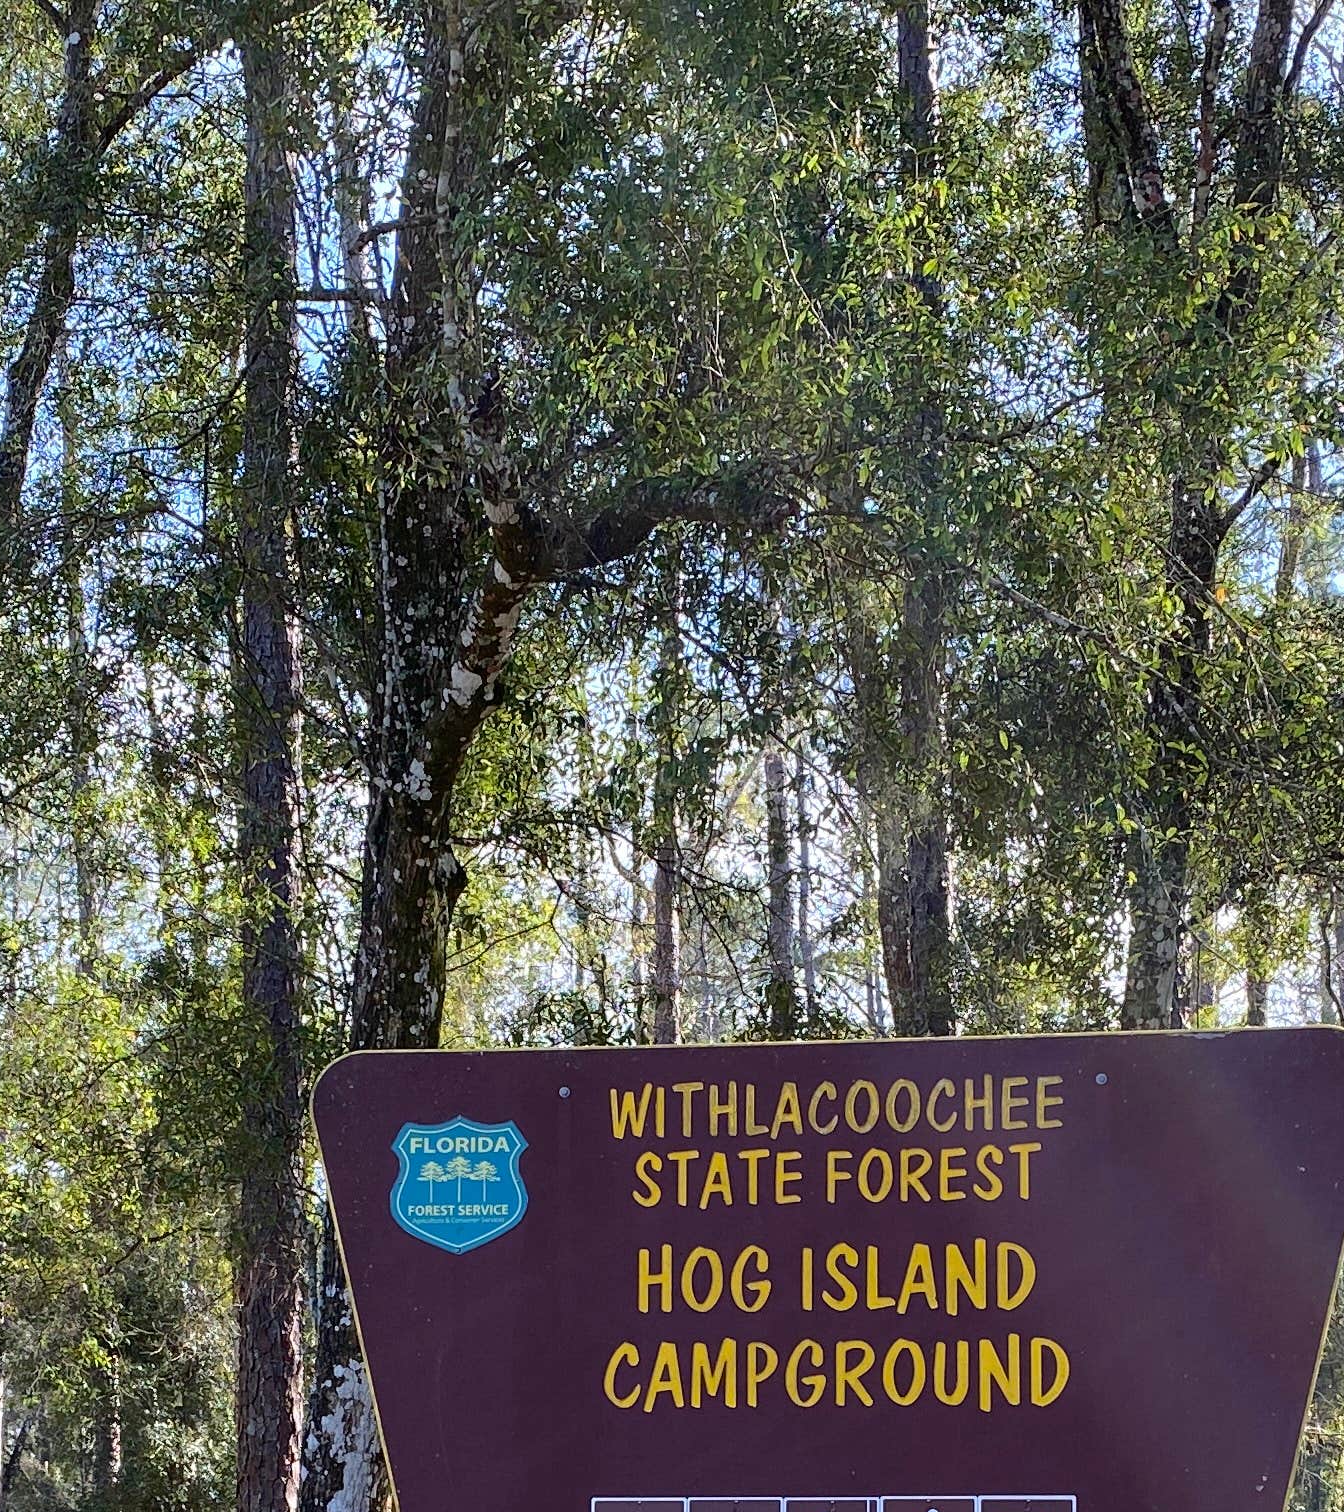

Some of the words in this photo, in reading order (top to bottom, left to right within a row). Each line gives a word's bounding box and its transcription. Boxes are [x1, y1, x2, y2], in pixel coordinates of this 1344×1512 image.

[609, 1074, 1064, 1140] WITHLACOOCHEE
[409, 1136, 511, 1154] FLORIDA
[632, 1148, 803, 1209] STATE
[826, 1141, 1043, 1204] FOREST
[407, 1204, 456, 1217] FOREST
[458, 1203, 509, 1216] SERVICE
[637, 1243, 772, 1314] HOG
[801, 1237, 1037, 1316] ISLAND
[602, 1332, 1070, 1414] CAMPGROUND
